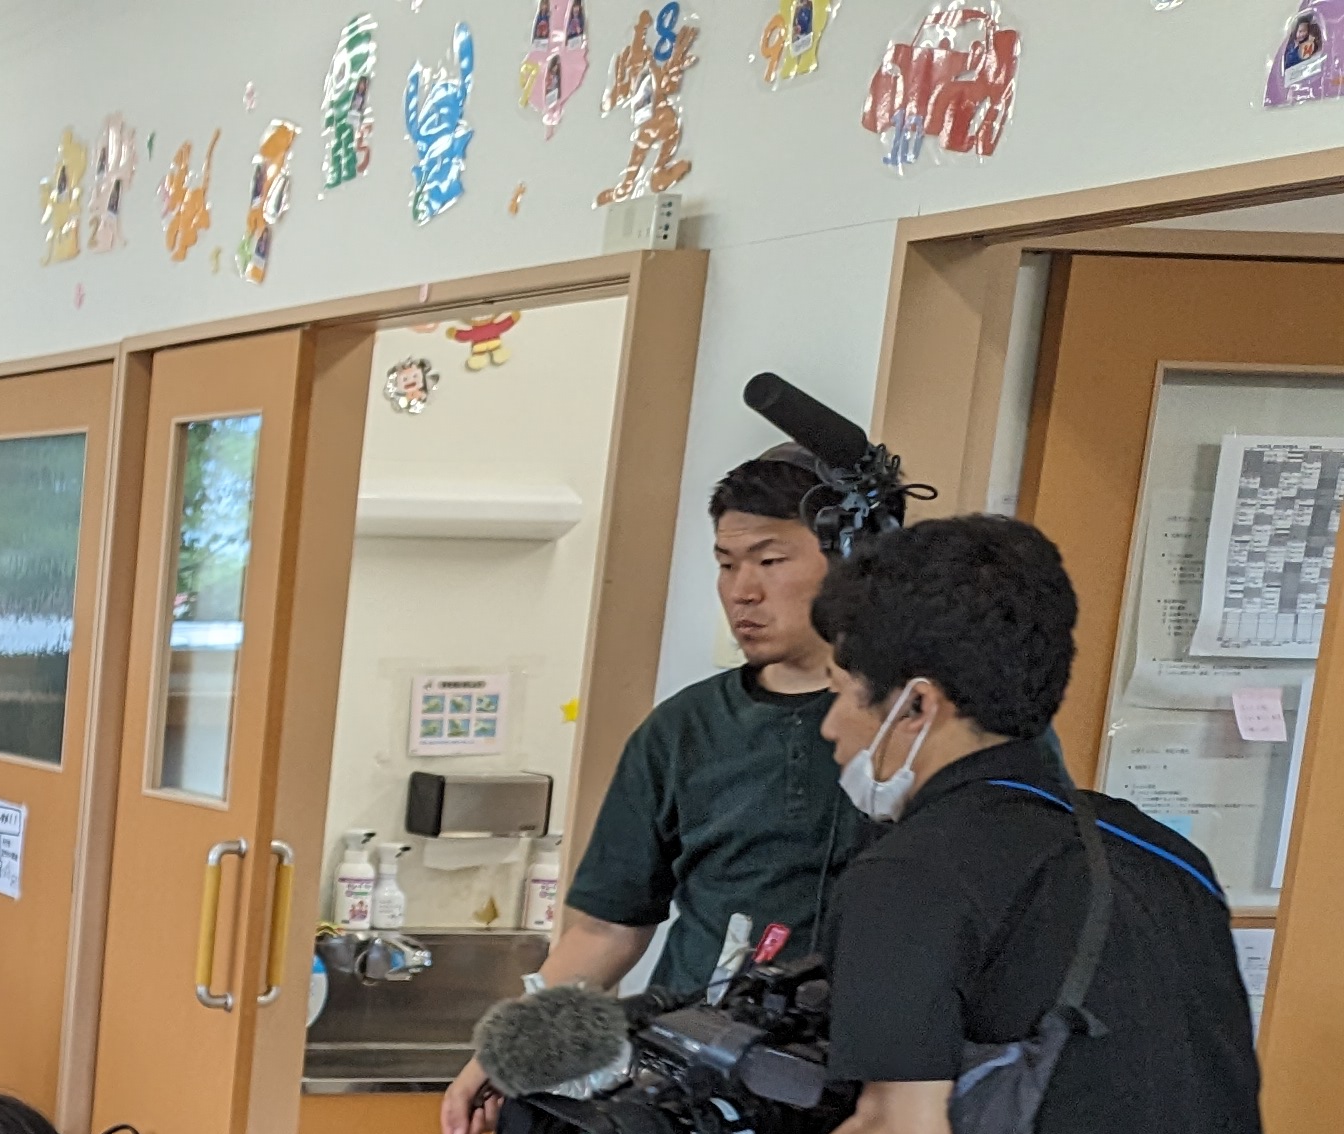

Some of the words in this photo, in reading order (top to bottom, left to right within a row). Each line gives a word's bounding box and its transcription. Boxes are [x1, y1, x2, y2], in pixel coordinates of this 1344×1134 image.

[653, 1, 680, 62] 8
[760, 14, 786, 83] 9
[518, 61, 540, 109] 7
[356, 124, 373, 173] 5
[882, 108, 925, 166] 10
